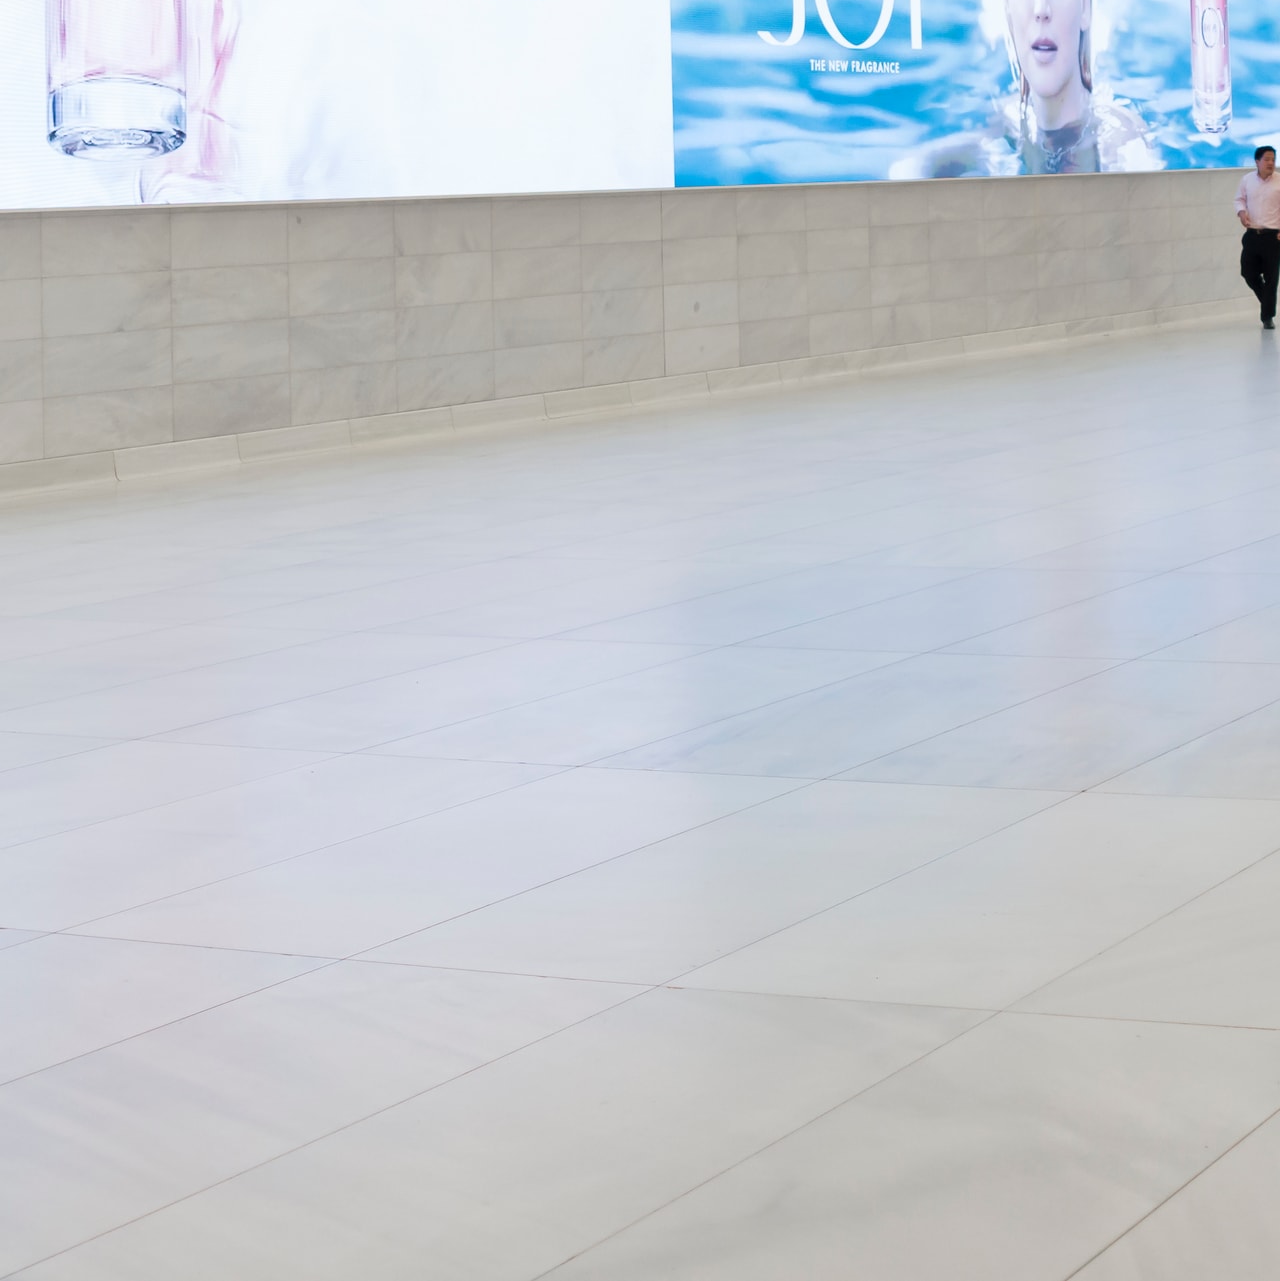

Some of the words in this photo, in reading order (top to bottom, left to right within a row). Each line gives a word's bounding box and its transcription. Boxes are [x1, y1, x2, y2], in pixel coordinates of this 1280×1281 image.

[809, 58, 826, 72] THE
[828, 59, 848, 73] NEW
[851, 60, 900, 74] FRAGRANCE
